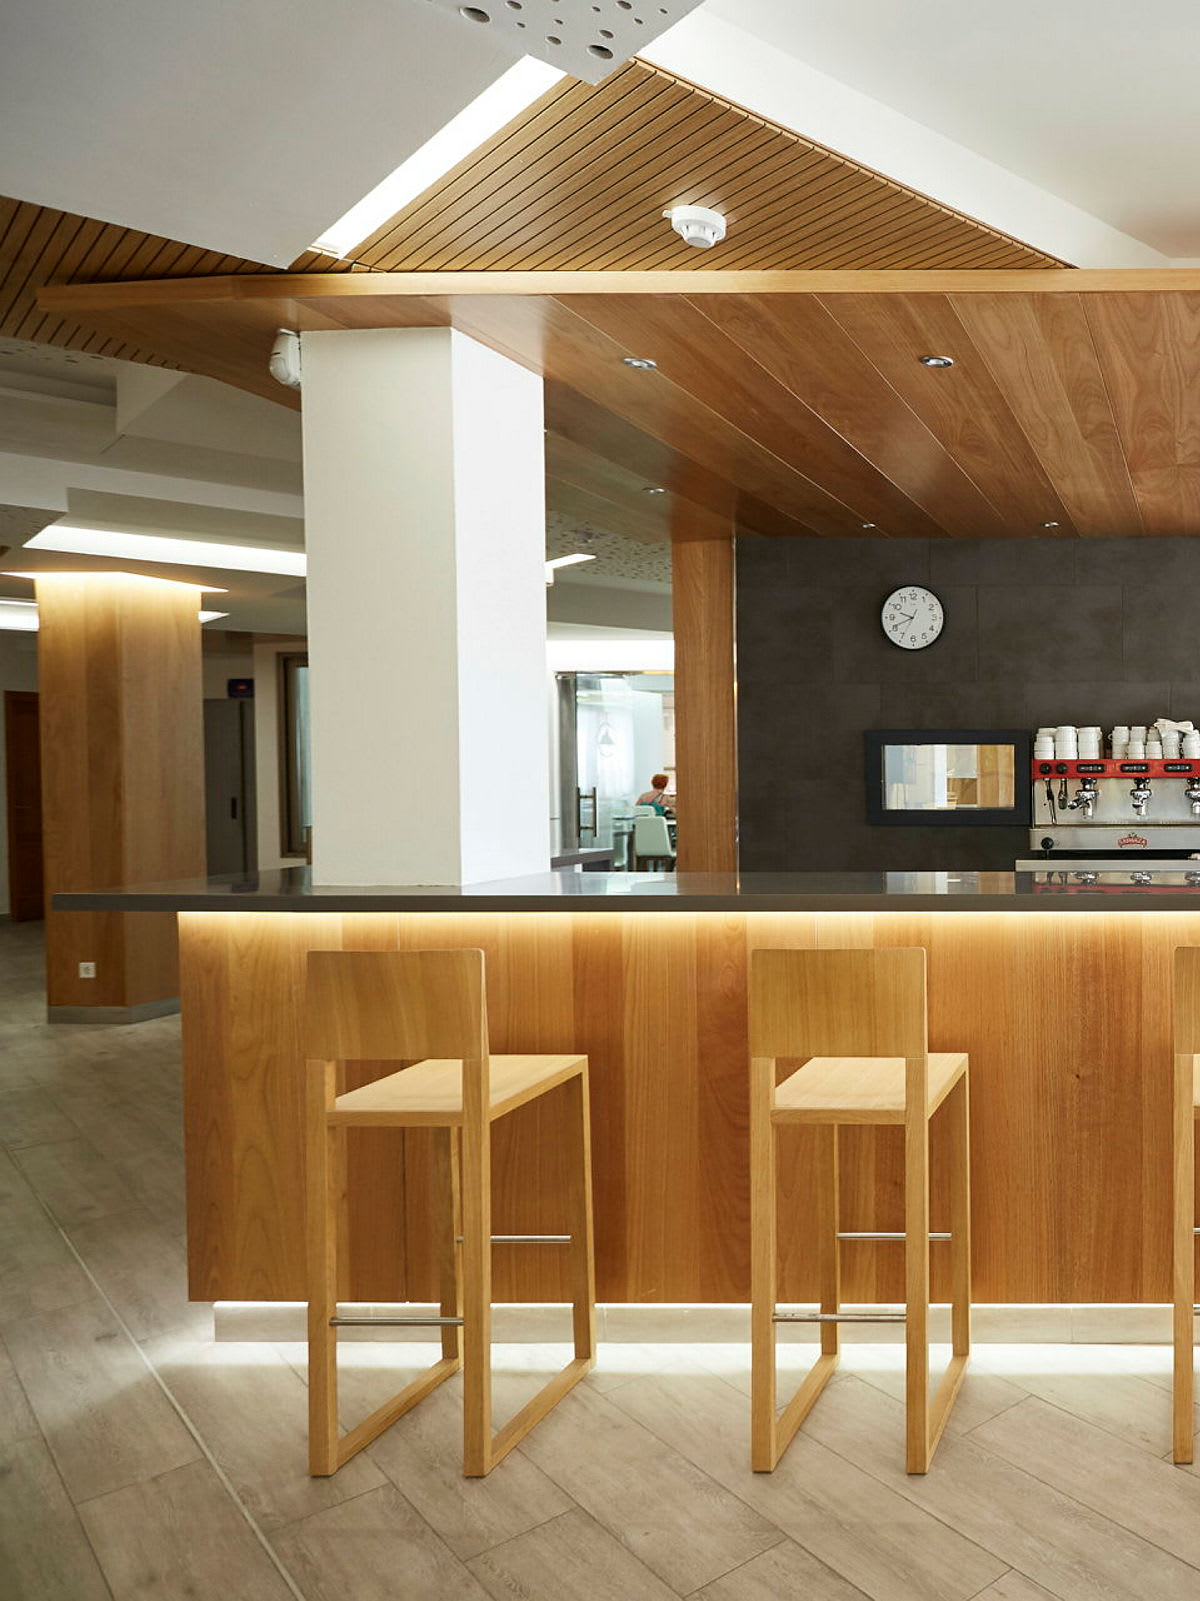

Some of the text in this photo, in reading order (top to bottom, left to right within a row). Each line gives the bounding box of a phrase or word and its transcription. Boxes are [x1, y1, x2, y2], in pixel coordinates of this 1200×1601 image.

[909, 593, 918, 601] 12
[928, 603, 935, 611] 2
[929, 624, 935, 632] 4
